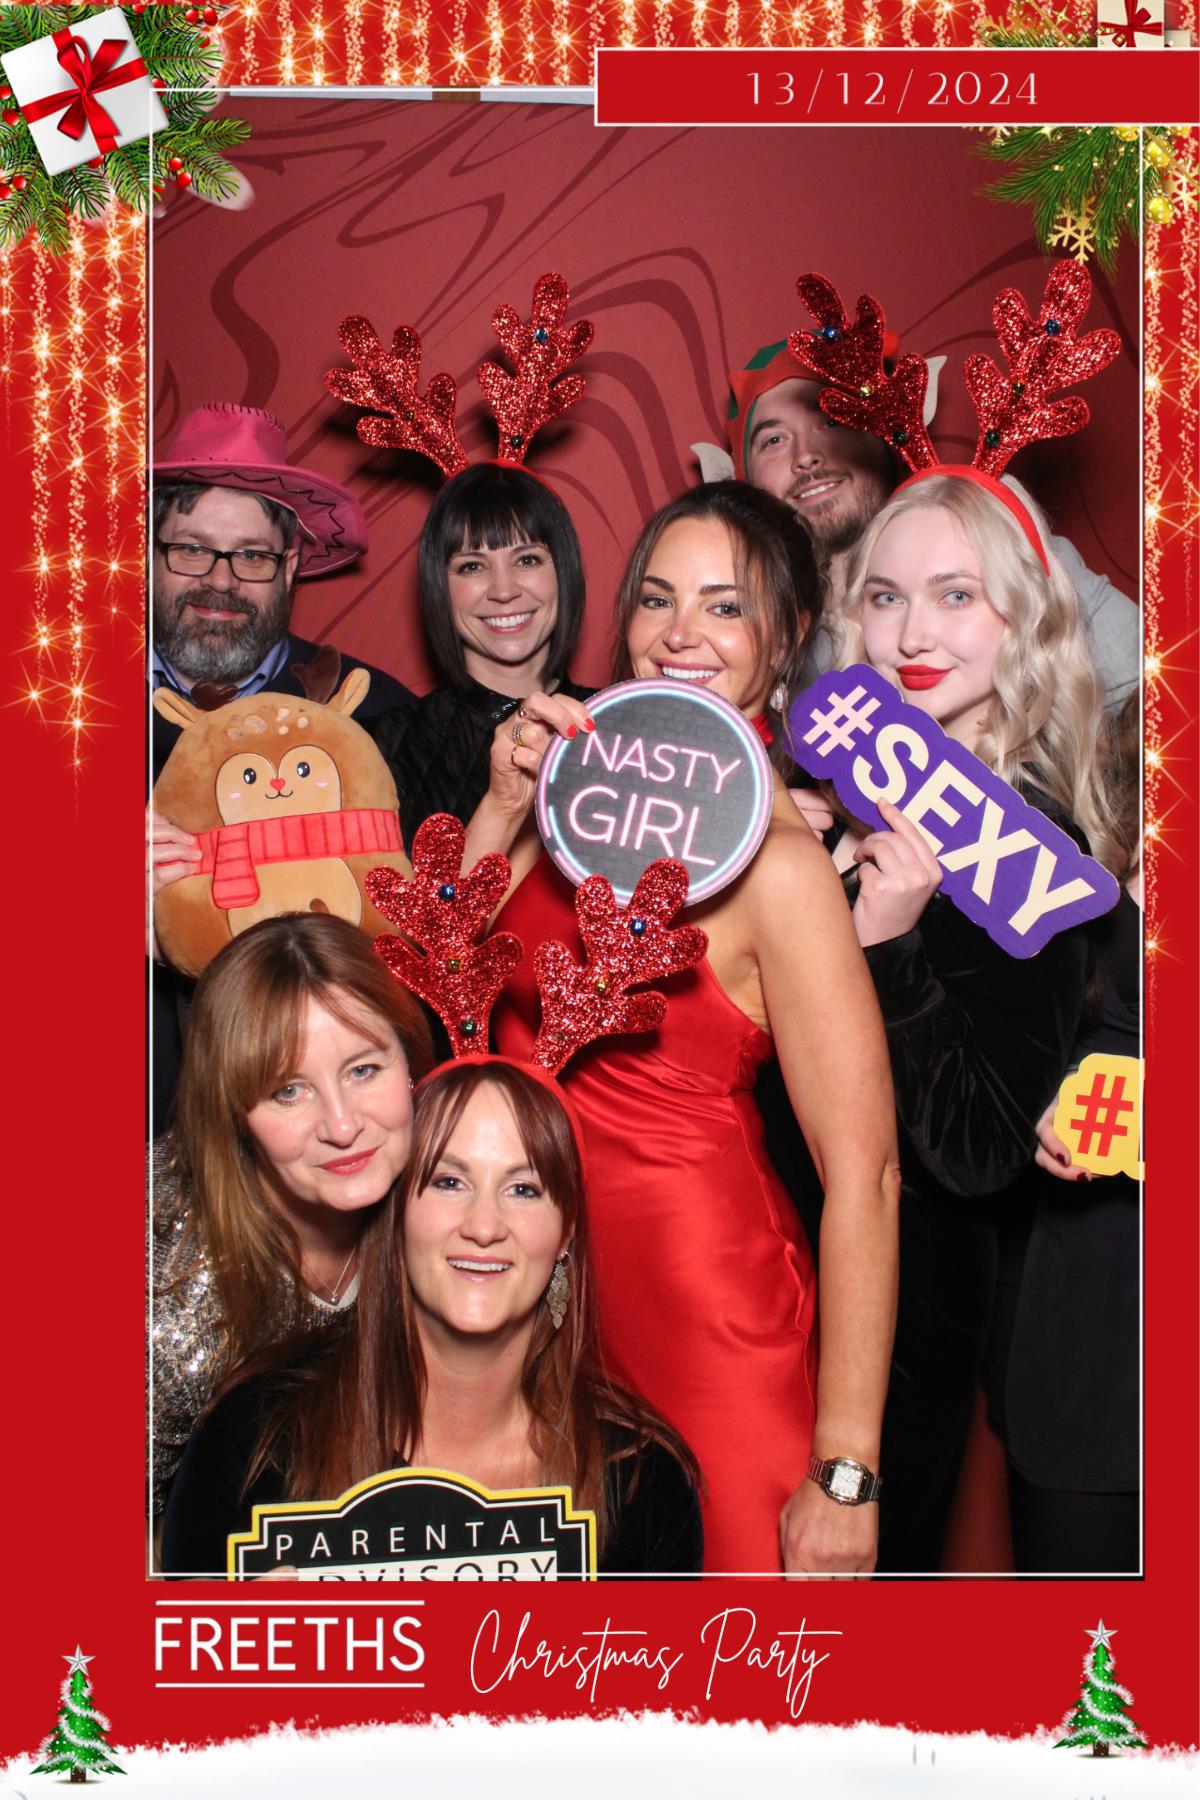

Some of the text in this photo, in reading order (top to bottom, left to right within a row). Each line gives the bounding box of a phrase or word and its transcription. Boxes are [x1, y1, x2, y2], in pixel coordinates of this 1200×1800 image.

[581, 731, 742, 794] NASTY
[568, 785, 716, 867] GIRL
[802, 684, 1097, 936] #SEXY
[275, 1516, 556, 1560] PARENTAL
